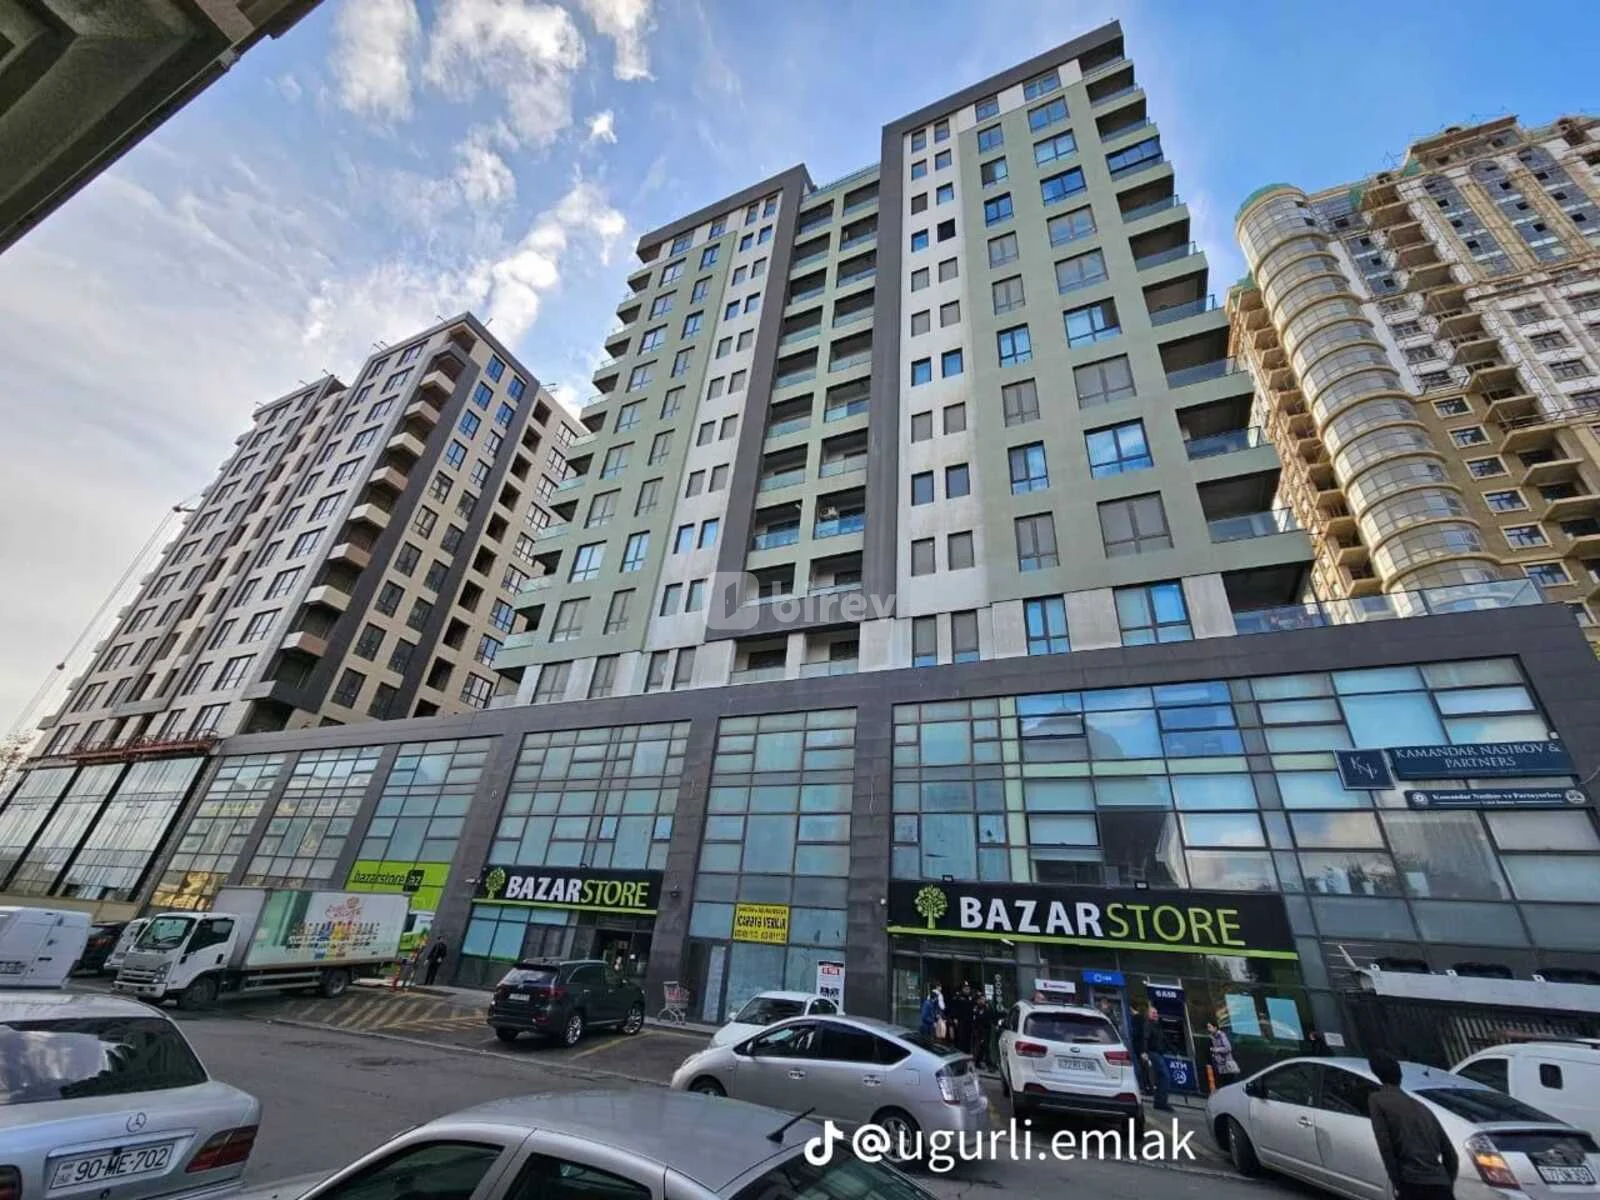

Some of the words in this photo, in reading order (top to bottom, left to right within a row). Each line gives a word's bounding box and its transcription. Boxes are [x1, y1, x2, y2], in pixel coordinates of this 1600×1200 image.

[1396, 745, 1477, 759] KAMANDAR
[1548, 743, 1562, 752] &
[1444, 756, 1517, 769] PARTNERS
[505, 875, 650, 907] BAZARSTORE
[959, 896, 1246, 946] BAZARSTORE
[74, 1148, 168, 1181] 90-ME-702
